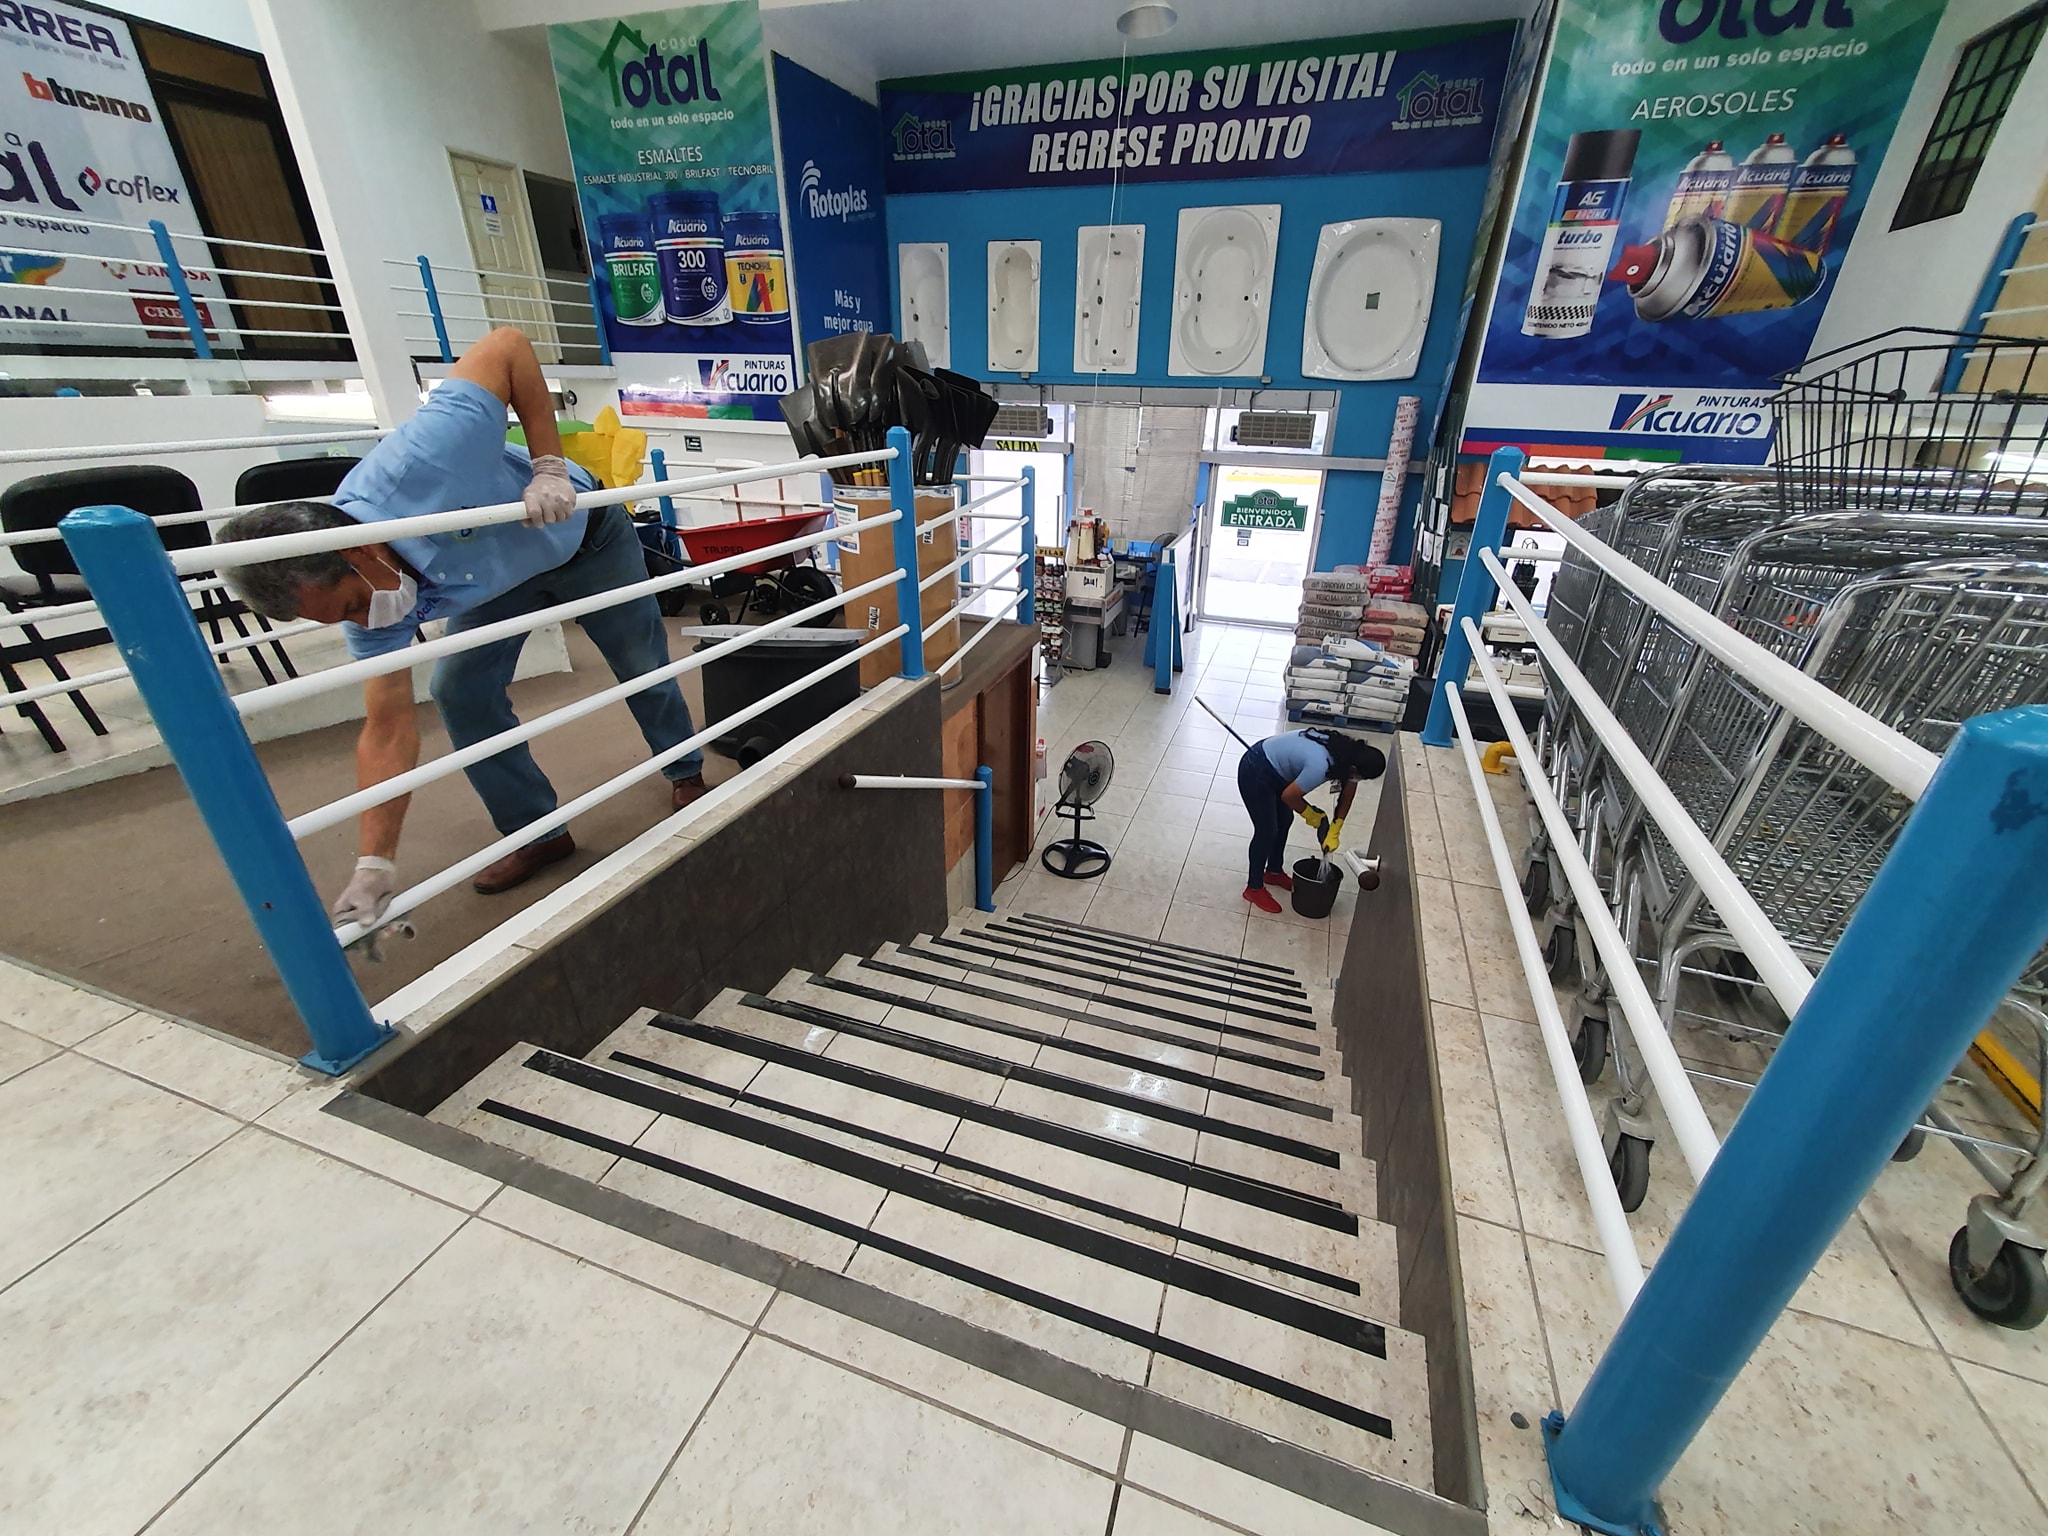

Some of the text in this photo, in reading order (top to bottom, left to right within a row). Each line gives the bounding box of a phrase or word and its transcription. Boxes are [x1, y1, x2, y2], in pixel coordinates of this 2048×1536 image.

[1611, 38, 1869, 77] todo en un solo espacio
[1123, 69, 1194, 117] POR
[1200, 63, 1250, 111] SU
[1256, 50, 1398, 107] VISITA!
[23, 72, 152, 123] bticino
[1630, 87, 1799, 121] AEROSOLES
[610, 108, 734, 129] todo en un solo espacio
[1028, 114, 1312, 173] REGRESE PRONTO
[637, 146, 703, 165] ESMALTES
[583, 173, 617, 185] ESMALTE
[618, 171, 662, 183] INDUSTRIAL
[664, 171, 678, 180] 300
[684, 167, 720, 179] BRILFAST
[727, 164, 774, 176] TECNOBRIL
[106, 175, 180, 204] coflex
[809, 185, 868, 223] Rotoplas
[1557, 229, 1603, 245] turbo
[612, 262, 655, 277] BRILFAST
[677, 250, 706, 268] 300
[134, 264, 211, 281] LASA
[834, 289, 861, 314] Más y
[143, 305, 206, 320] CRET
[823, 313, 851, 334] mejor
[744, 360, 785, 370] PINTURAS
[1696, 395, 1771, 408] PINTURAS
[996, 440, 1038, 452] SALIDA
[1230, 513, 1296, 528] ENTRADA
[1236, 507, 1292, 516] BIENVENIDOS
[869, 607, 878, 629] FRAGIL
